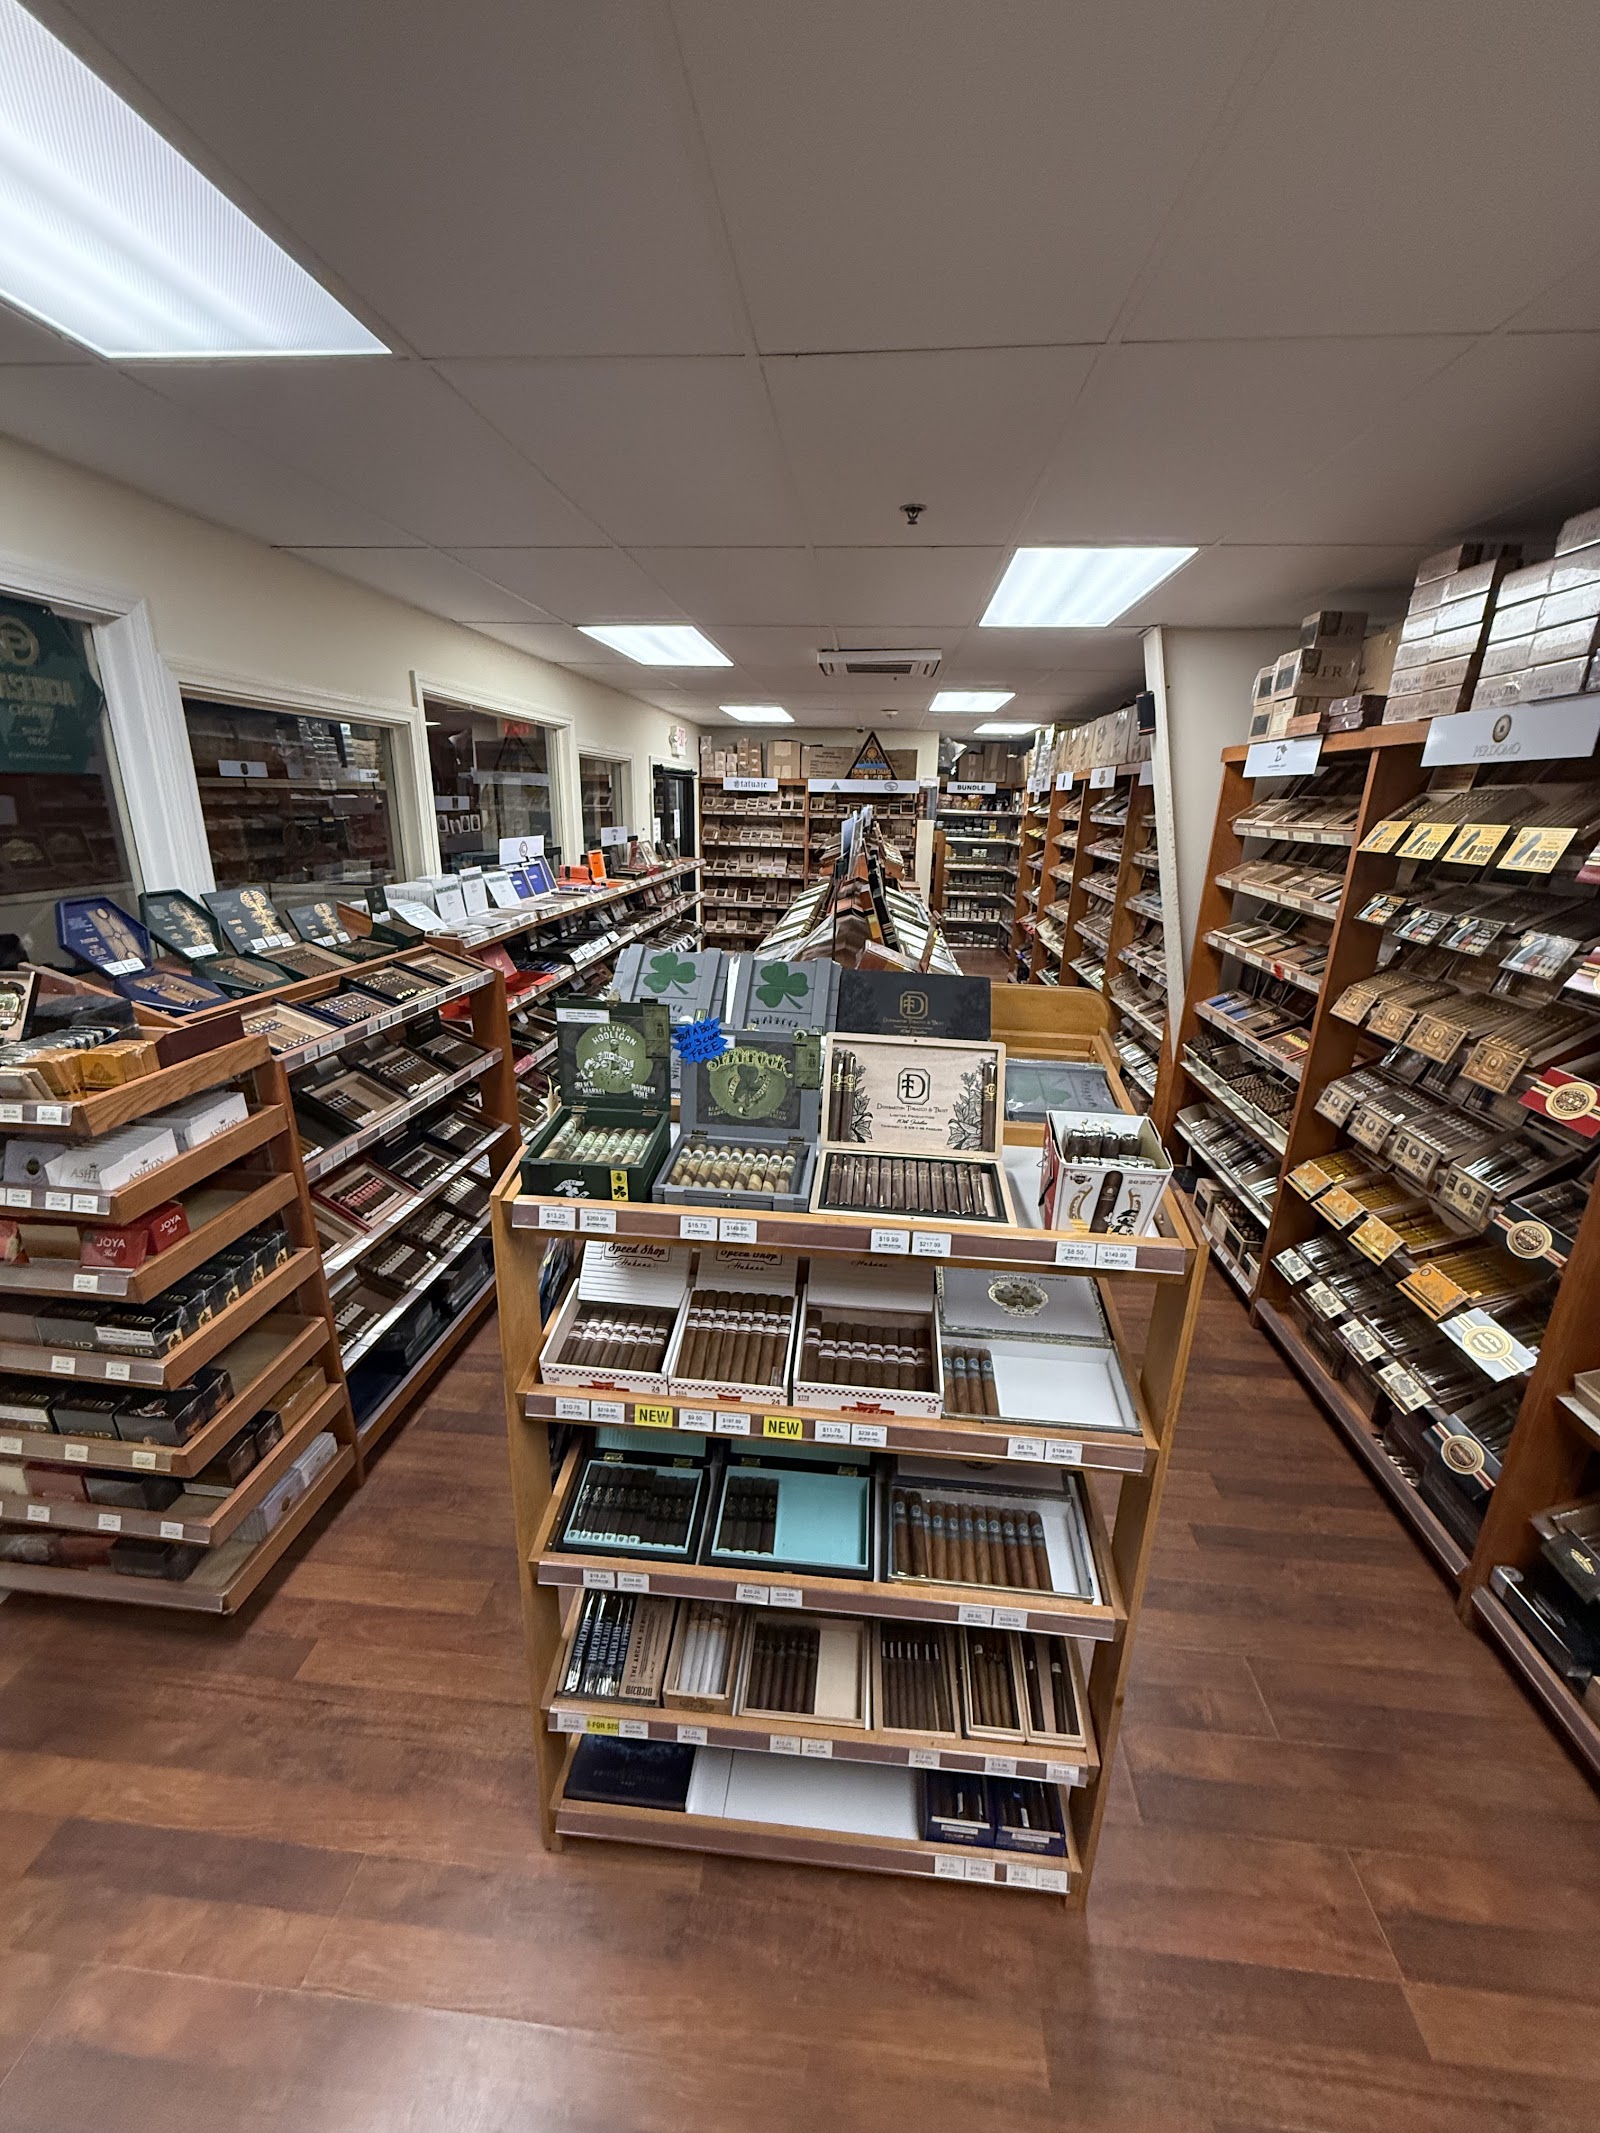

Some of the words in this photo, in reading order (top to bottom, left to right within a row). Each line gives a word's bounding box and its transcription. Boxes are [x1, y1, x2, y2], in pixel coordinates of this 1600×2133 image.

[1473, 742, 1521, 757] PERDOMO
[599, 1025, 627, 1033] FILTHY
[699, 1022, 716, 1034] BOX
[592, 1032, 637, 1046] HOOLIGAN
[691, 1041, 721, 1060] FREE
[633, 1090, 649, 1099] POLE
[210, 1117, 240, 1138] ASHTON
[71, 1168, 100, 1179] ASHT
[129, 1155, 165, 1182] ASHTON
[160, 1214, 182, 1232] JOYA
[96, 1238, 126, 1247] JOYA
[608, 1243, 638, 1254] Speed
[641, 1244, 666, 1255] Shop
[727, 1262, 765, 1271] Habana
[639, 1409, 669, 1423] NEW
[768, 1420, 799, 1435] NEW
[592, 1721, 606, 1729] FOR
